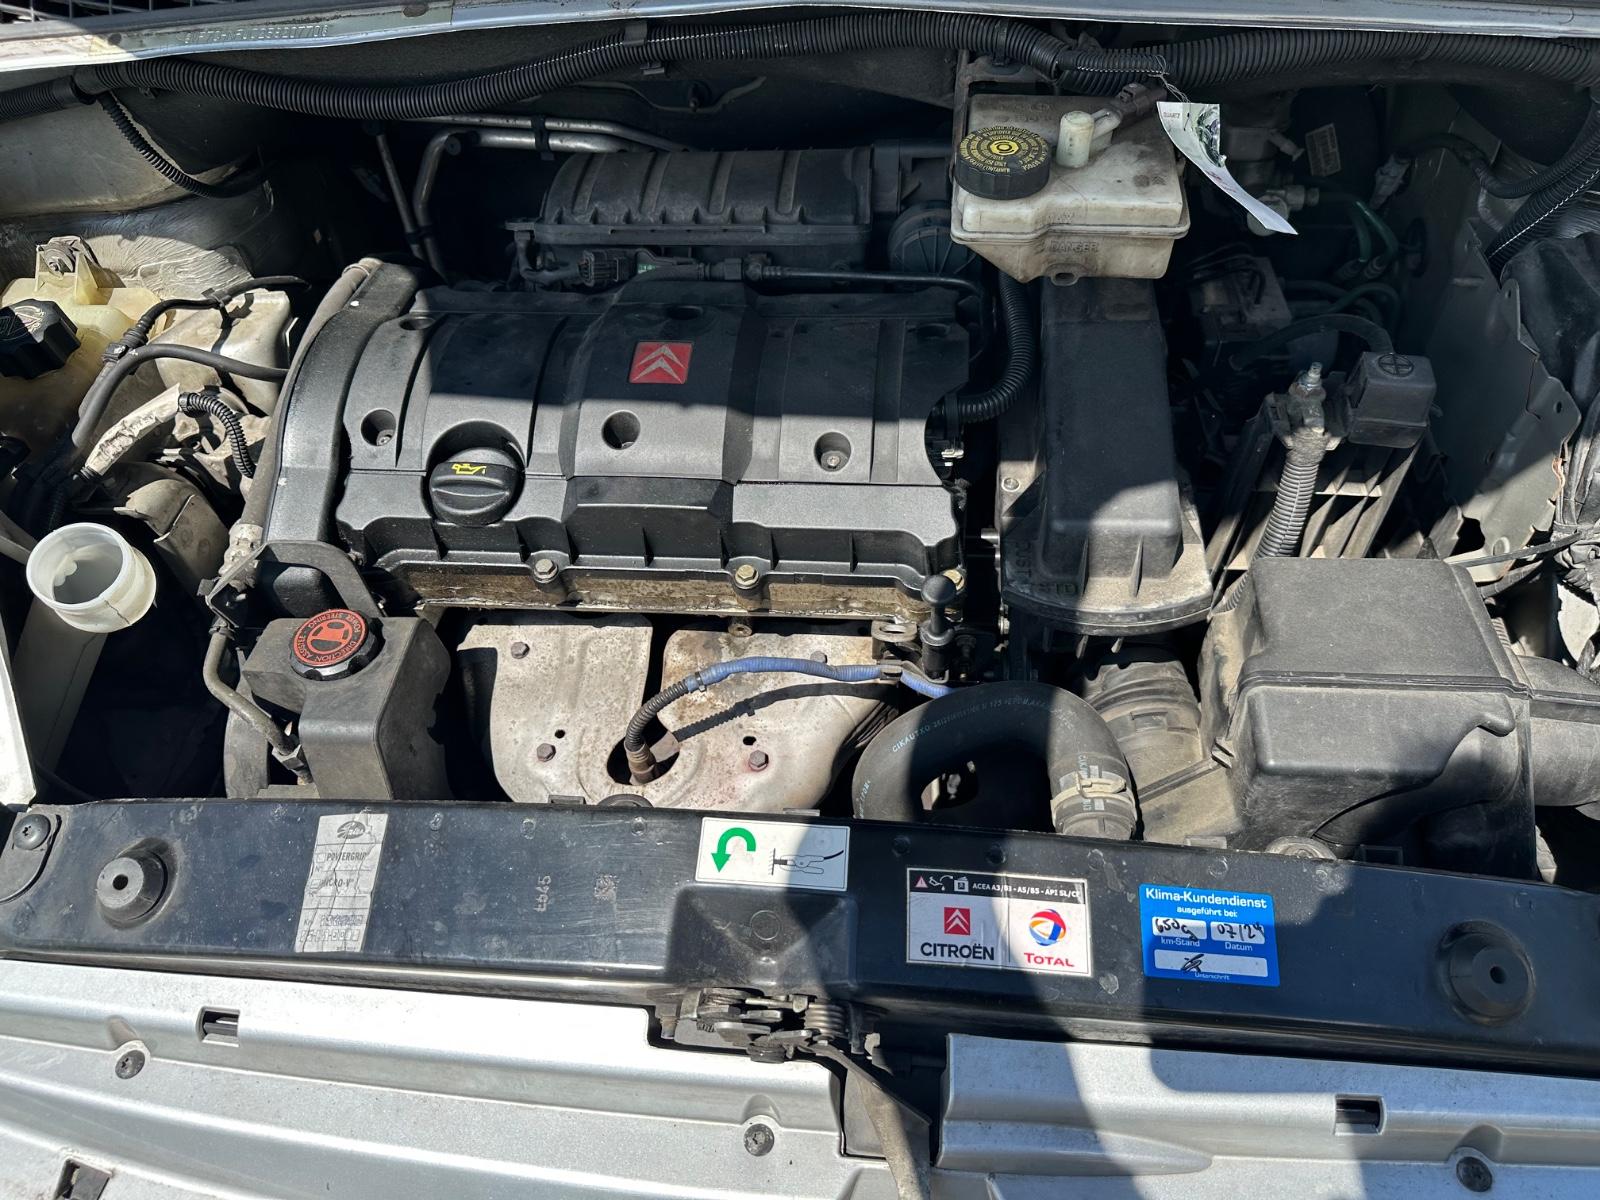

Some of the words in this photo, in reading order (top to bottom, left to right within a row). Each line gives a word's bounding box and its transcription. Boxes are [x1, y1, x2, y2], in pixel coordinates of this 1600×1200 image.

[972, 882, 991, 890] ACEA
[1045, 888, 1058, 897] API
[1145, 887, 1268, 909] Klima-Kundendienst
[1176, 906, 1222, 917] ausgeführt
[1223, 909, 1238, 918] bei:
[1160, 936, 1201, 948] km-Stand
[1224, 942, 1253, 952] Datum
[920, 941, 995, 961] CITROËN
[1023, 952, 1075, 968] TOTAL
[1194, 971, 1231, 981] Unterschrift
